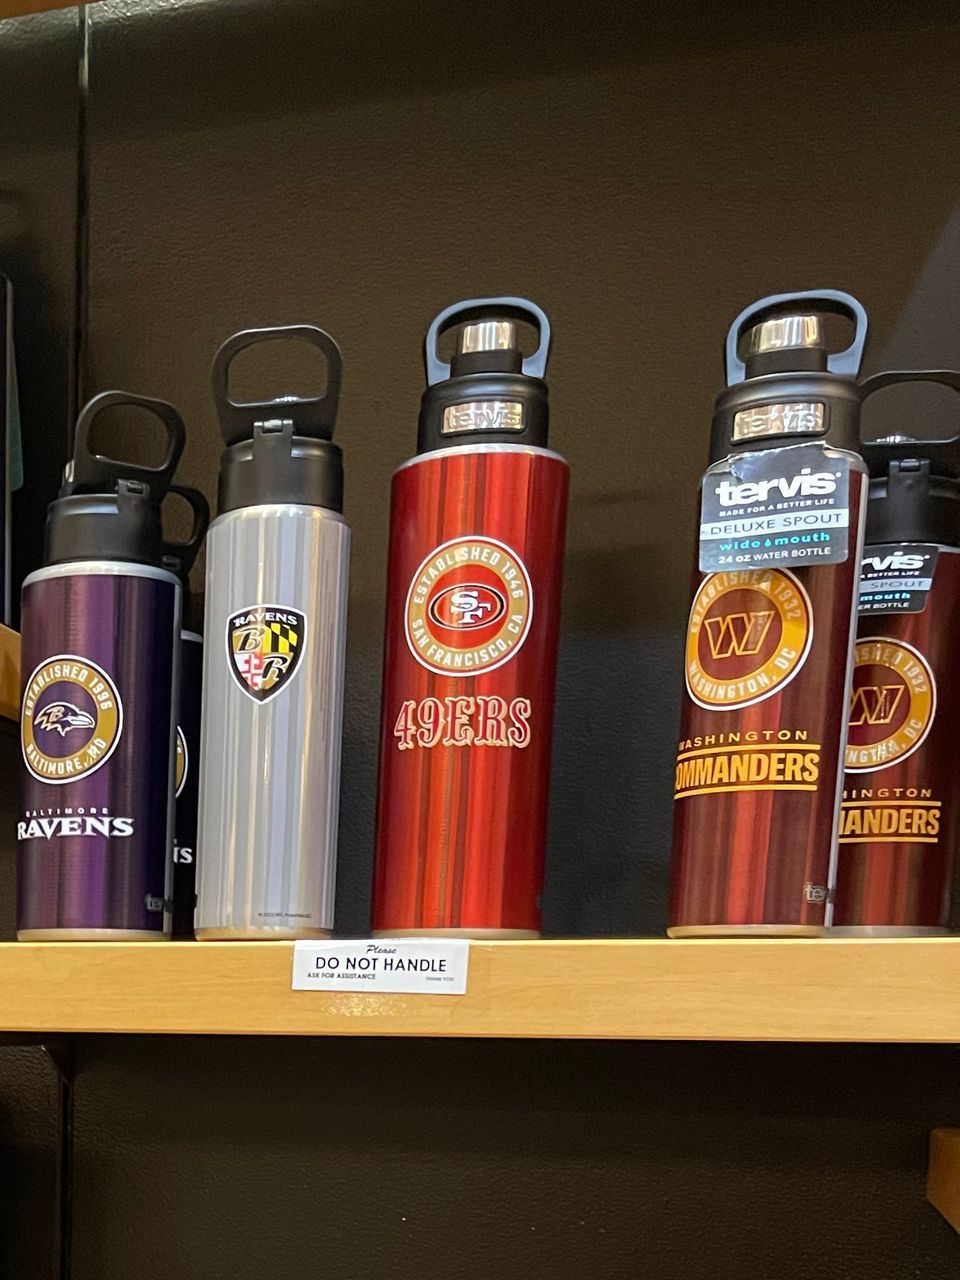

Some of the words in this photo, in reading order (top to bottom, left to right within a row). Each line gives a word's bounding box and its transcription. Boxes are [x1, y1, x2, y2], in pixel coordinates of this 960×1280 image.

[715, 468, 837, 507] tervis
[719, 508, 744, 517] MADE
[747, 506, 766, 514] FOR
[777, 500, 813, 510] BETTER
[815, 498, 835, 506] LIFE
[710, 519, 775, 535] DELUXE
[783, 513, 842, 527] SPOUT
[720, 540, 761, 551] wide
[775, 532, 830, 545] mouth
[718, 556, 734, 564] 24
[736, 554, 751, 563] OZ
[753, 551, 789, 561] WATER
[791, 547, 831, 557] BOTTLE
[414, 547, 501, 605] ESTABLISHED
[500, 561, 524, 599] 1946
[871, 580, 924, 590] SPOUT
[233, 612, 298, 627] RAVENS
[412, 618, 427, 648] SAN
[507, 613, 523, 636] CA
[394, 695, 531, 751] 49ERS
[25, 806, 109, 818] BALTIMORE
[17, 817, 134, 841] RAVENS
[366, 944, 397, 955] Please
[315, 956, 339, 970] DO
[346, 957, 378, 971] NOT
[384, 958, 447, 972] HANDLE
[336, 972, 376, 980] ASSISTANCE
